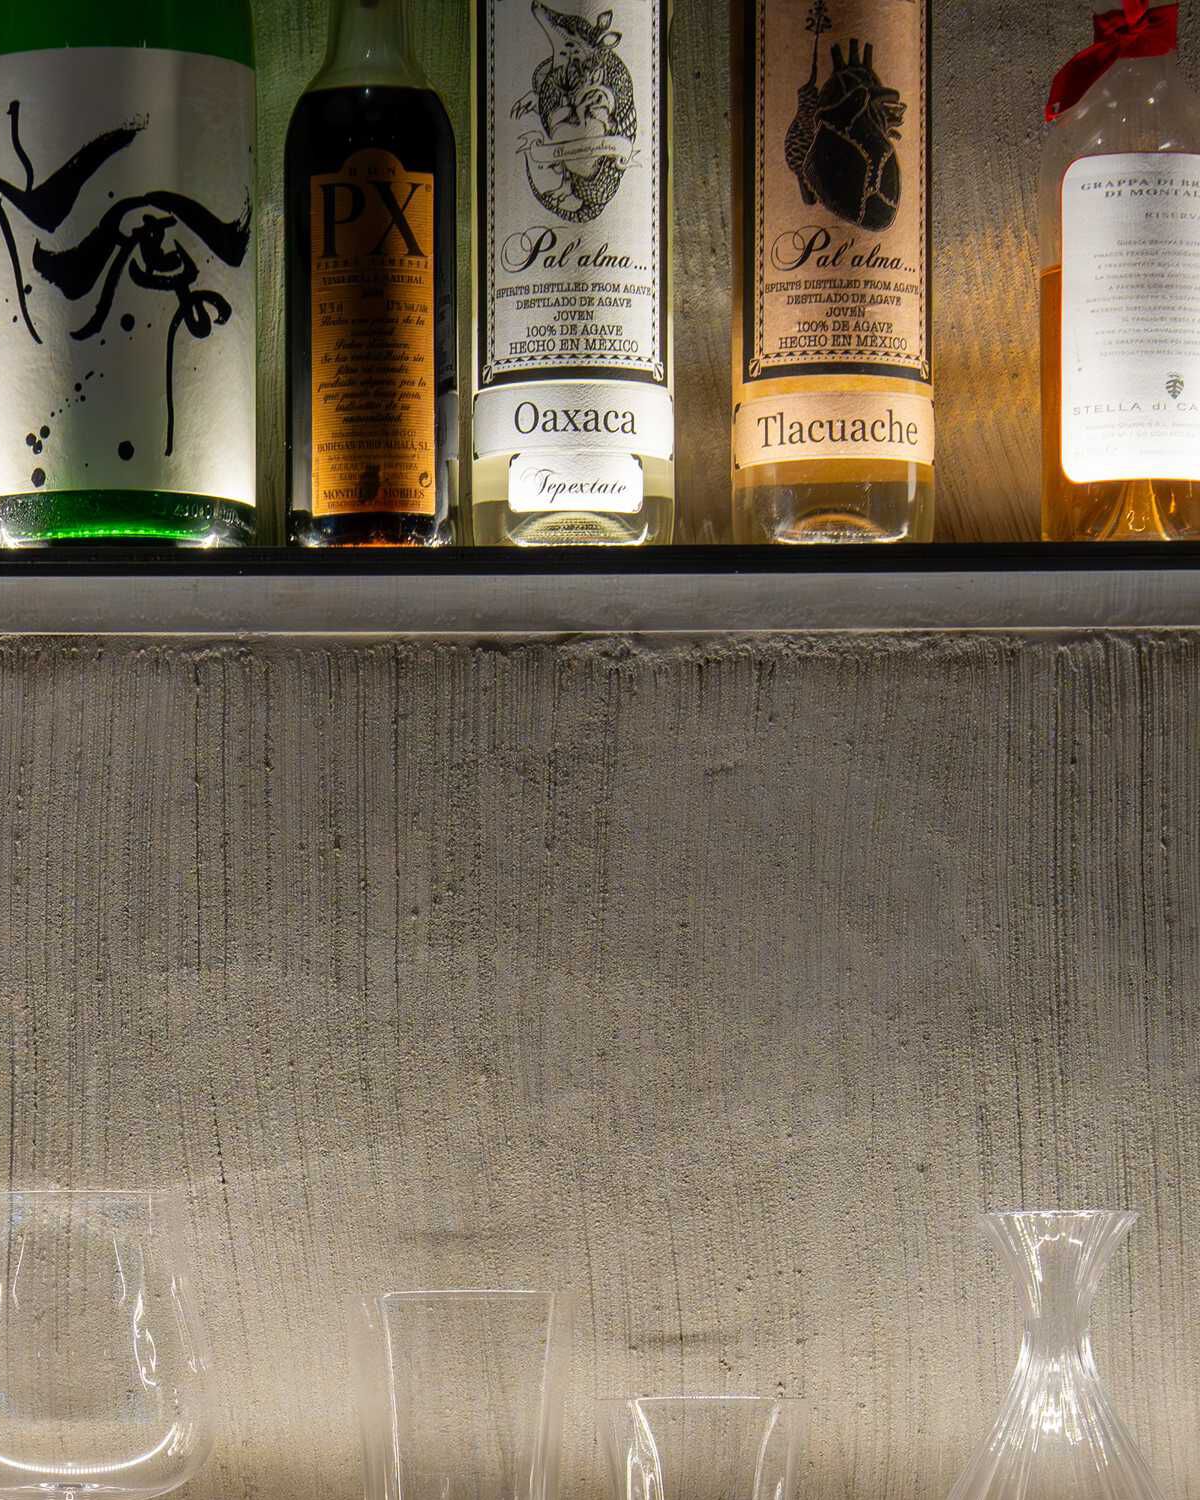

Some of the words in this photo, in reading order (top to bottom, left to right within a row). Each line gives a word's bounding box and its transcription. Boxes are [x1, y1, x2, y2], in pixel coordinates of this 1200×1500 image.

[1081, 179, 1149, 191] GRAPPA
[1157, 179, 1174, 187] DI
[1104, 190, 1123, 198] DI
[319, 181, 429, 258] PX
[496, 285, 530, 299] SPIRITS
[532, 282, 589, 294] DISTILLED
[591, 282, 621, 293] FROM
[623, 284, 651, 296] AGAVE
[765, 280, 801, 294] SPIRITS
[804, 278, 860, 290] DISTILLED
[863, 279, 891, 290] FROM
[893, 282, 920, 295] AGAVE
[516, 297, 577, 310] DESTILADO
[579, 297, 595, 307] DE
[597, 297, 632, 308] AGAVE
[786, 293, 849, 305] DESTILADO
[851, 293, 867, 304] DE
[869, 294, 902, 306] AGAVE
[553, 310, 594, 321] JOVEN
[825, 306, 866, 318] JOVEN
[526, 325, 556, 338] 100%
[560, 325, 578, 335] DE
[581, 325, 623, 336] AGAVE
[797, 321, 829, 333] 100%
[832, 320, 849, 331] DE
[852, 321, 893, 333] AGAVE
[509, 340, 555, 355] HECHO
[559, 339, 580, 351] EN
[778, 335, 827, 349] HECHO
[831, 334, 853, 347] EN
[1072, 401, 1143, 416] STELLA
[514, 401, 637, 435] Oaxaca
[757, 408, 919, 448] Tlacuache
[520, 466, 629, 503] Tepextate
